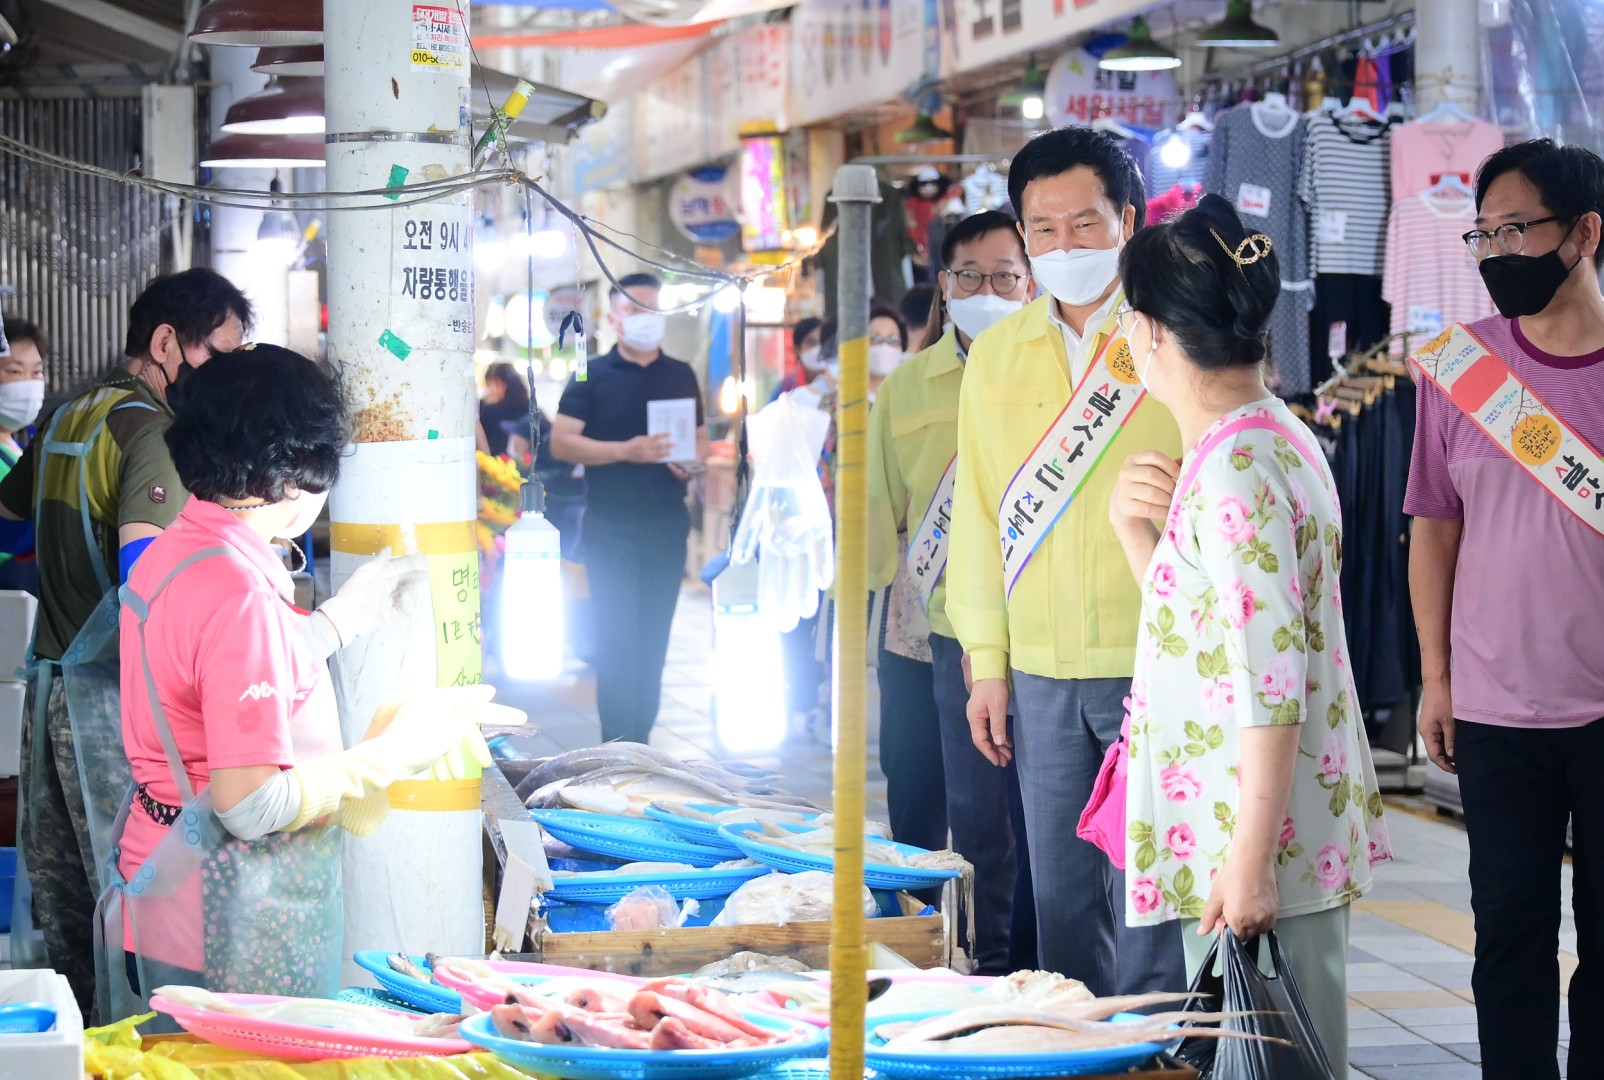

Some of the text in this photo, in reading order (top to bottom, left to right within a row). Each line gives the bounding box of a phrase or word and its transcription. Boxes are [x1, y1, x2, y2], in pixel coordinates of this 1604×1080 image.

[403, 219, 432, 250] 오전
[440, 222, 459, 252] 9시
[1035, 382, 1121, 492] 살맛나는
